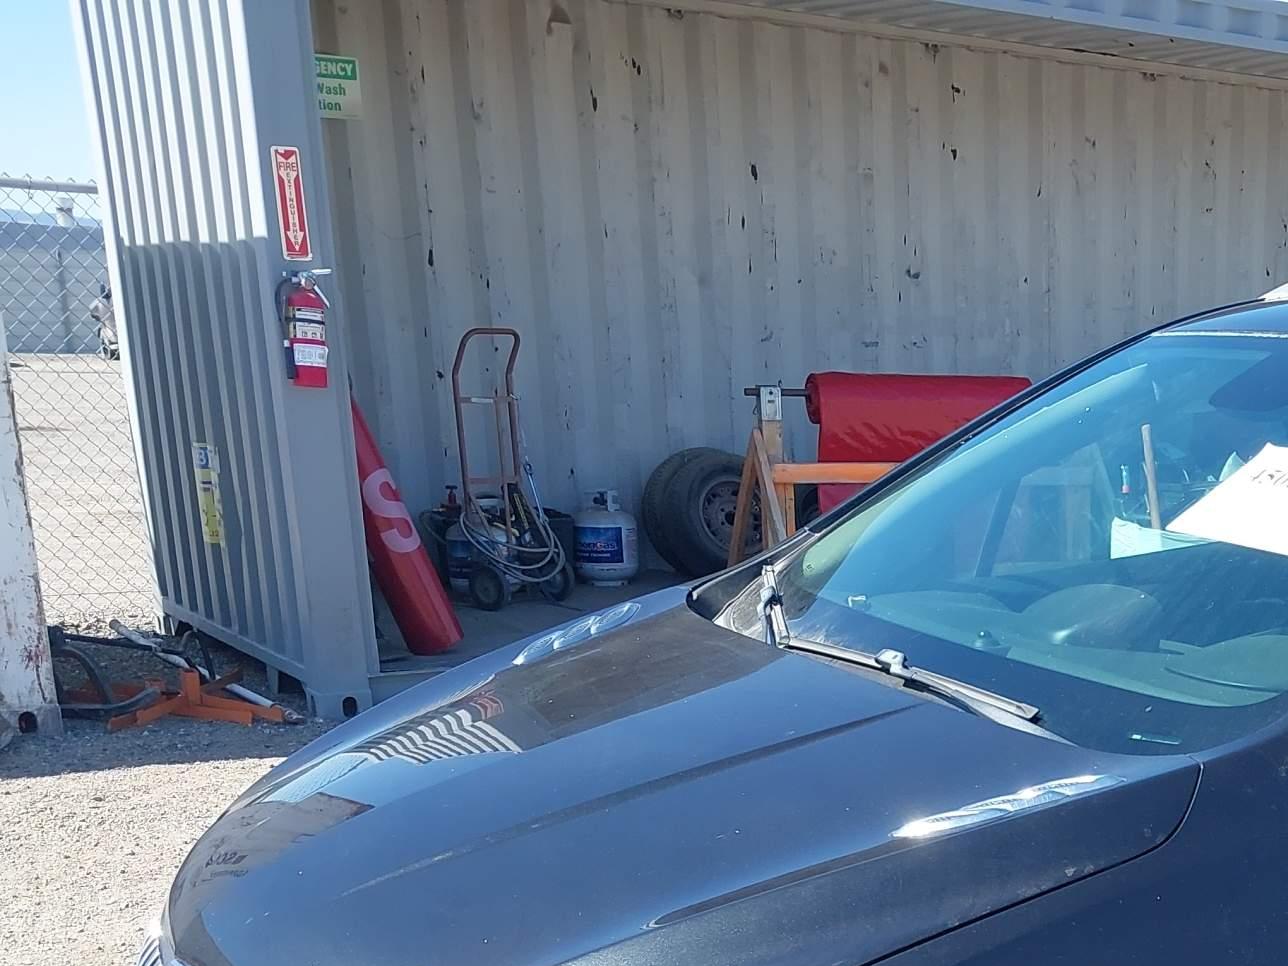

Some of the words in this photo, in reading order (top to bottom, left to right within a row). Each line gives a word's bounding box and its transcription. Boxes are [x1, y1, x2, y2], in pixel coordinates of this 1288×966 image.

[319, 98, 342, 111] tion
[278, 161, 298, 172] FIRE
[285, 172, 300, 246] EXTINGUISHER
